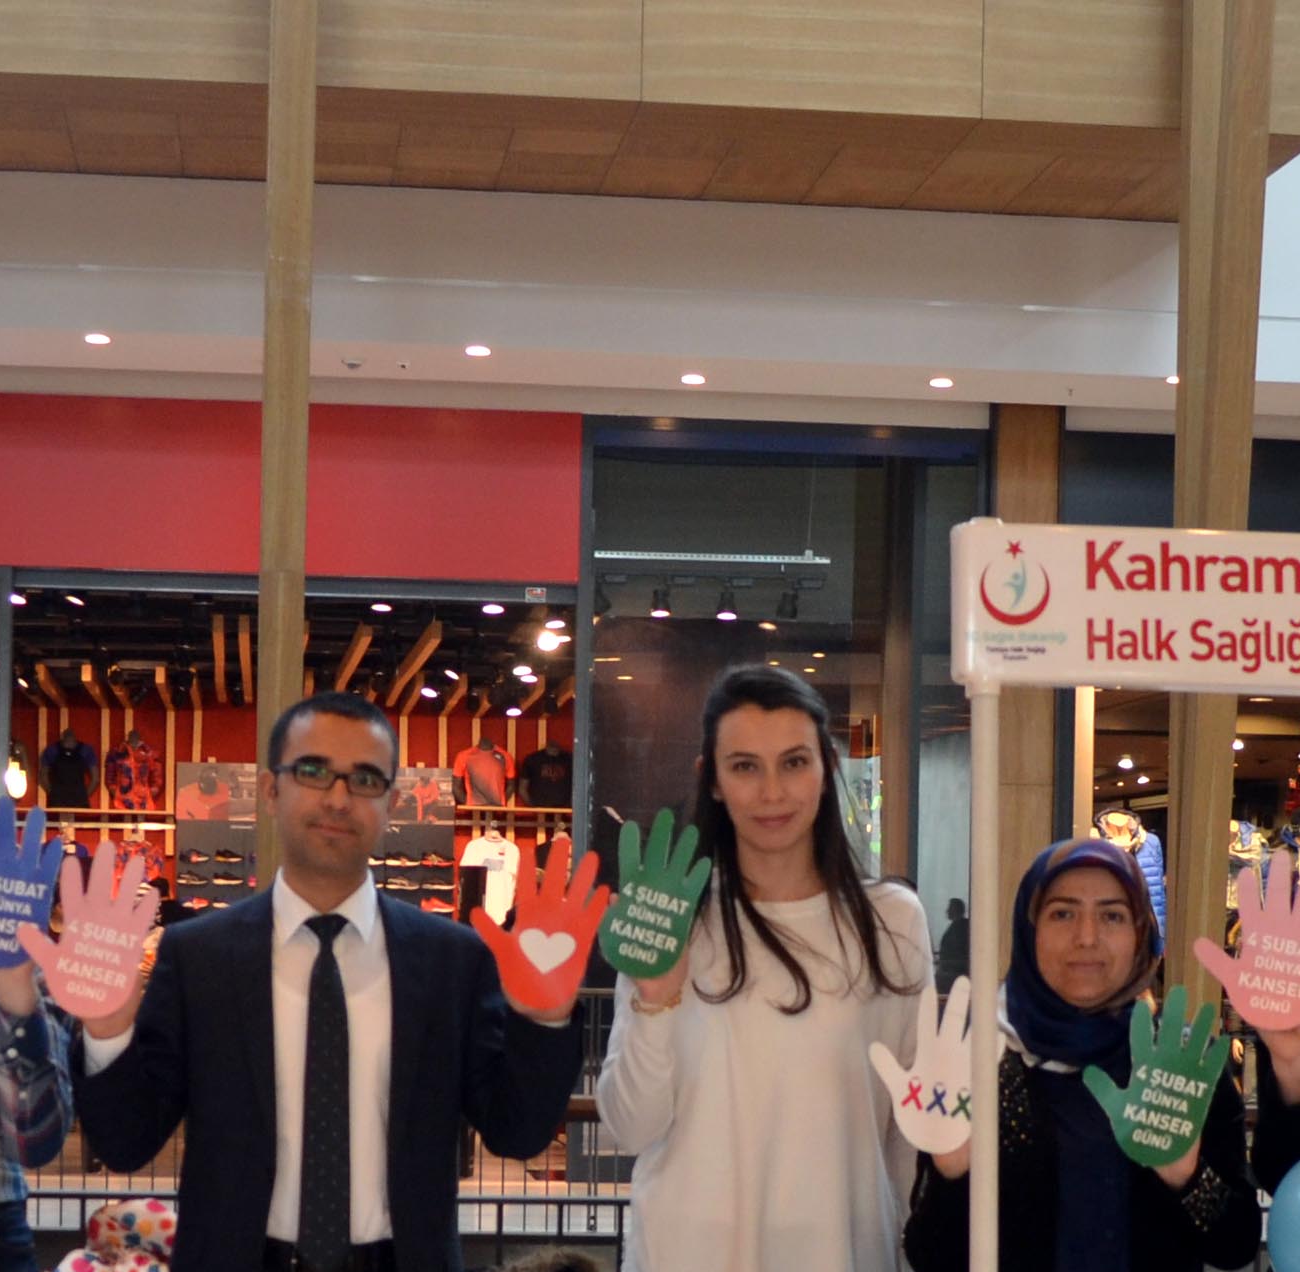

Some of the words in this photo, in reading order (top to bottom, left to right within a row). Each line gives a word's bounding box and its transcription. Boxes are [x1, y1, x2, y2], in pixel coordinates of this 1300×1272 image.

[1085, 618, 1177, 662] Halk
[626, 904, 672, 930] DÜNYA
[68, 920, 80, 933] 4
[82, 922, 138, 948] ŞUBAT
[610, 918, 679, 953] KANSER
[1247, 932, 1258, 947] 4
[74, 941, 121, 965] DÜNYA
[618, 942, 659, 965] GÜNÜ
[56, 957, 127, 989] KANSER
[65, 982, 107, 1001] GÜNÜ
[1250, 993, 1292, 1014] GÜNÜ
[1136, 1065, 1148, 1081] 4
[1150, 1068, 1208, 1101] ŞUBAT
[1141, 1088, 1188, 1114] DÜNYA
[1123, 1103, 1194, 1138] KANSER
[1132, 1128, 1172, 1150] GÜNÜ
